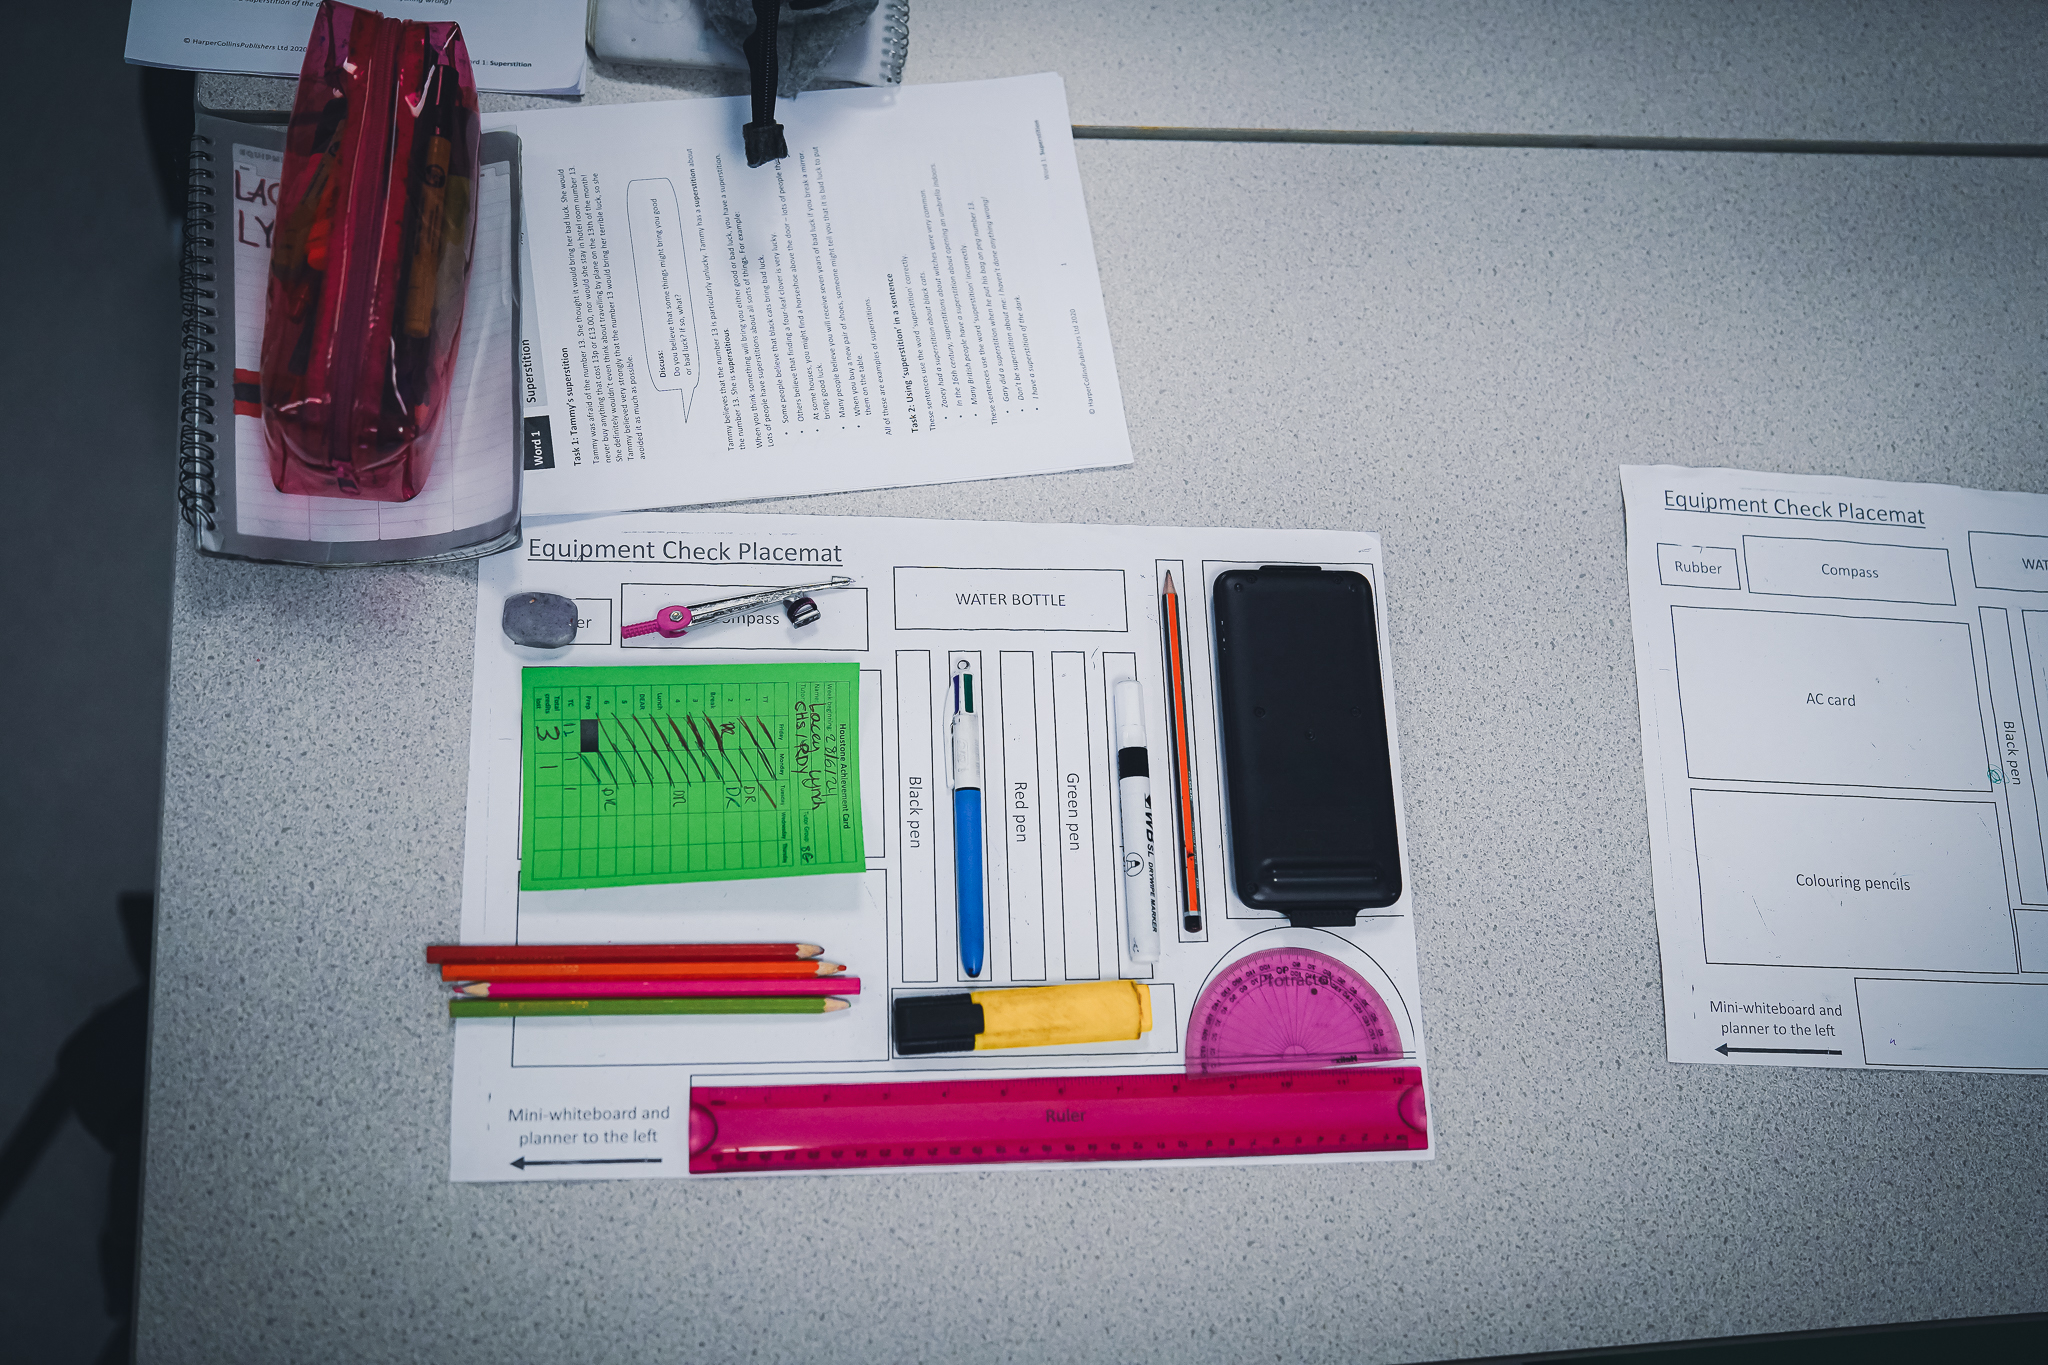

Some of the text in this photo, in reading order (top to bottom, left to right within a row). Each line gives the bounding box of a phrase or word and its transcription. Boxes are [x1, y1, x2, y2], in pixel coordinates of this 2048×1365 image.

[192, 38, 276, 51] HarperCollinsPublishers
[490, 60, 532, 68] Superstition
[556, 168, 566, 189] would
[560, 190, 568, 203] She
[561, 204, 569, 219] luck.
[563, 220, 571, 233] bad
[567, 247, 575, 265] bring
[757, 254, 765, 269] luck.
[568, 266, 578, 288] would
[759, 271, 767, 283] bad
[762, 284, 770, 302] bring
[886, 273, 898, 308] sentence
[573, 295, 582, 322] thought
[674, 293, 683, 315] what?
[767, 318, 775, 336] black
[892, 316, 900, 324] in
[576, 324, 584, 336] She
[577, 338, 585, 348] 13.
[679, 334, 688, 351] luck?
[723, 327, 735, 373] superstitious.
[770, 337, 778, 351] that
[579, 350, 589, 377] number
[657, 349, 666, 377] Discuss:
[682, 353, 690, 366] bad
[773, 353, 782, 377] believe
[521, 339, 537, 403] Superstition
[560, 347, 574, 396] superstition
[730, 382, 738, 395] She
[776, 379, 787, 402] people
[904, 379, 913, 402] Using
[585, 401, 594, 421] afraid
[780, 404, 789, 423] Some
[907, 404, 915, 412] 2:
[734, 409, 743, 436] number
[908, 413, 918, 433] Task
[570, 437, 579, 445] 1:
[533, 438, 544, 466] Word
[571, 447, 581, 466] Task
[591, 438, 599, 464] Tammy
[1664, 489, 1925, 525] Equipment Check Placemat
[529, 538, 843, 563] Equipment Check Placemat
[1674, 560, 1722, 575] Rubber
[1821, 563, 1879, 579] Compass
[955, 592, 1067, 607] WATER BOTTLE
[721, 612, 780, 627] mpass
[567, 699, 573, 707] TC
[762, 695, 768, 703] TT
[1806, 692, 1856, 707] AC card
[825, 701, 833, 731] beginning:
[2003, 720, 2021, 786] Black pen
[839, 724, 850, 829] Houstone Achievement Card
[907, 776, 921, 849] Black pen
[1012, 782, 1028, 843] Red pen
[1065, 772, 1080, 851] Green pen
[1147, 844, 1155, 858] SL
[1148, 861, 1156, 898] DRYWIPE
[1795, 873, 1911, 892] Colouring pencils
[1150, 898, 1158, 933] MARKER
[1709, 1000, 1843, 1017] Mini-whiteboard and
[1721, 1021, 1836, 1037] planner to the left
[508, 1105, 671, 1122] Mini-whiteboard and
[1046, 1108, 1086, 1124] Ruler
[519, 1128, 658, 1148] planner to the left
